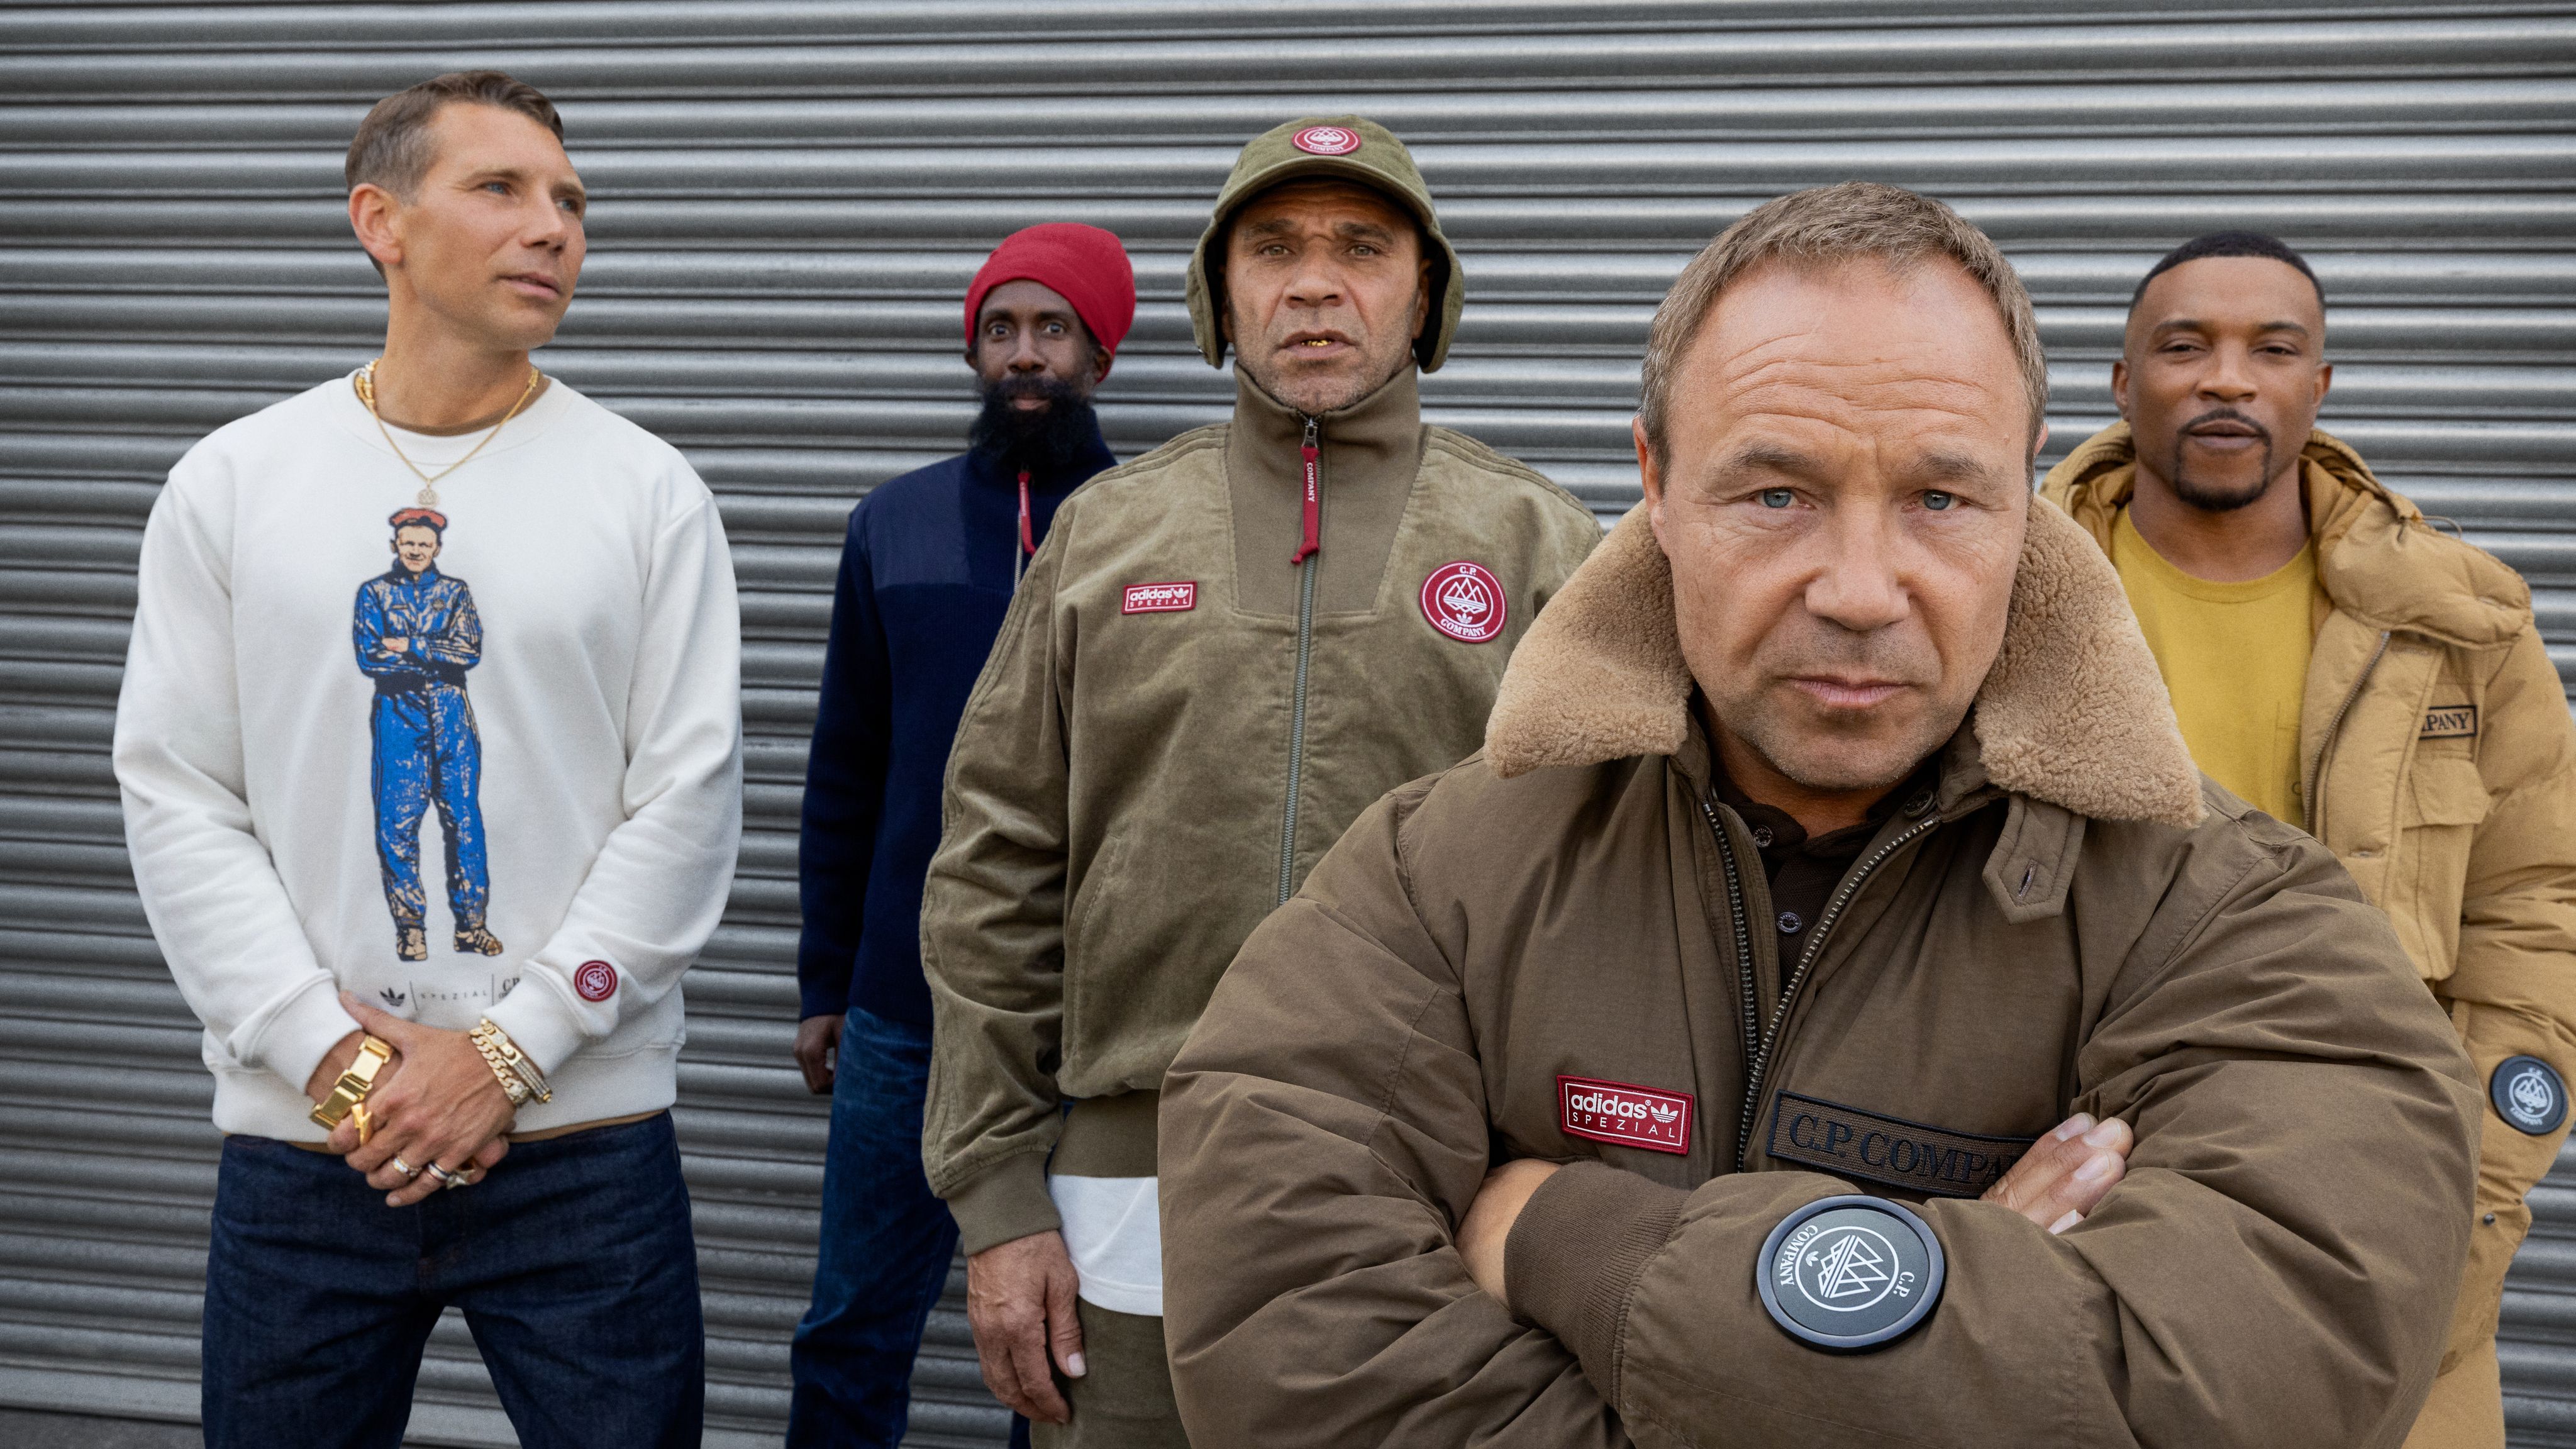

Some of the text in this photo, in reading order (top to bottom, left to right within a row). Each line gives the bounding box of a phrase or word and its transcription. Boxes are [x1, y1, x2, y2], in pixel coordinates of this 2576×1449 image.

[1460, 566, 1477, 575] C.P.
[1130, 598, 1187, 608] SPEZIAL
[1440, 618, 1486, 636] COMPANY
[2421, 712, 2470, 731] PANY
[421, 990, 487, 1000] SPEZIAL
[1573, 1112, 1675, 1138] SPEZIAL
[1789, 1113, 2020, 1185] C.P. COMPA
[1780, 1224, 1819, 1286] COMPANY
[1893, 1271, 1915, 1298] C.P.
